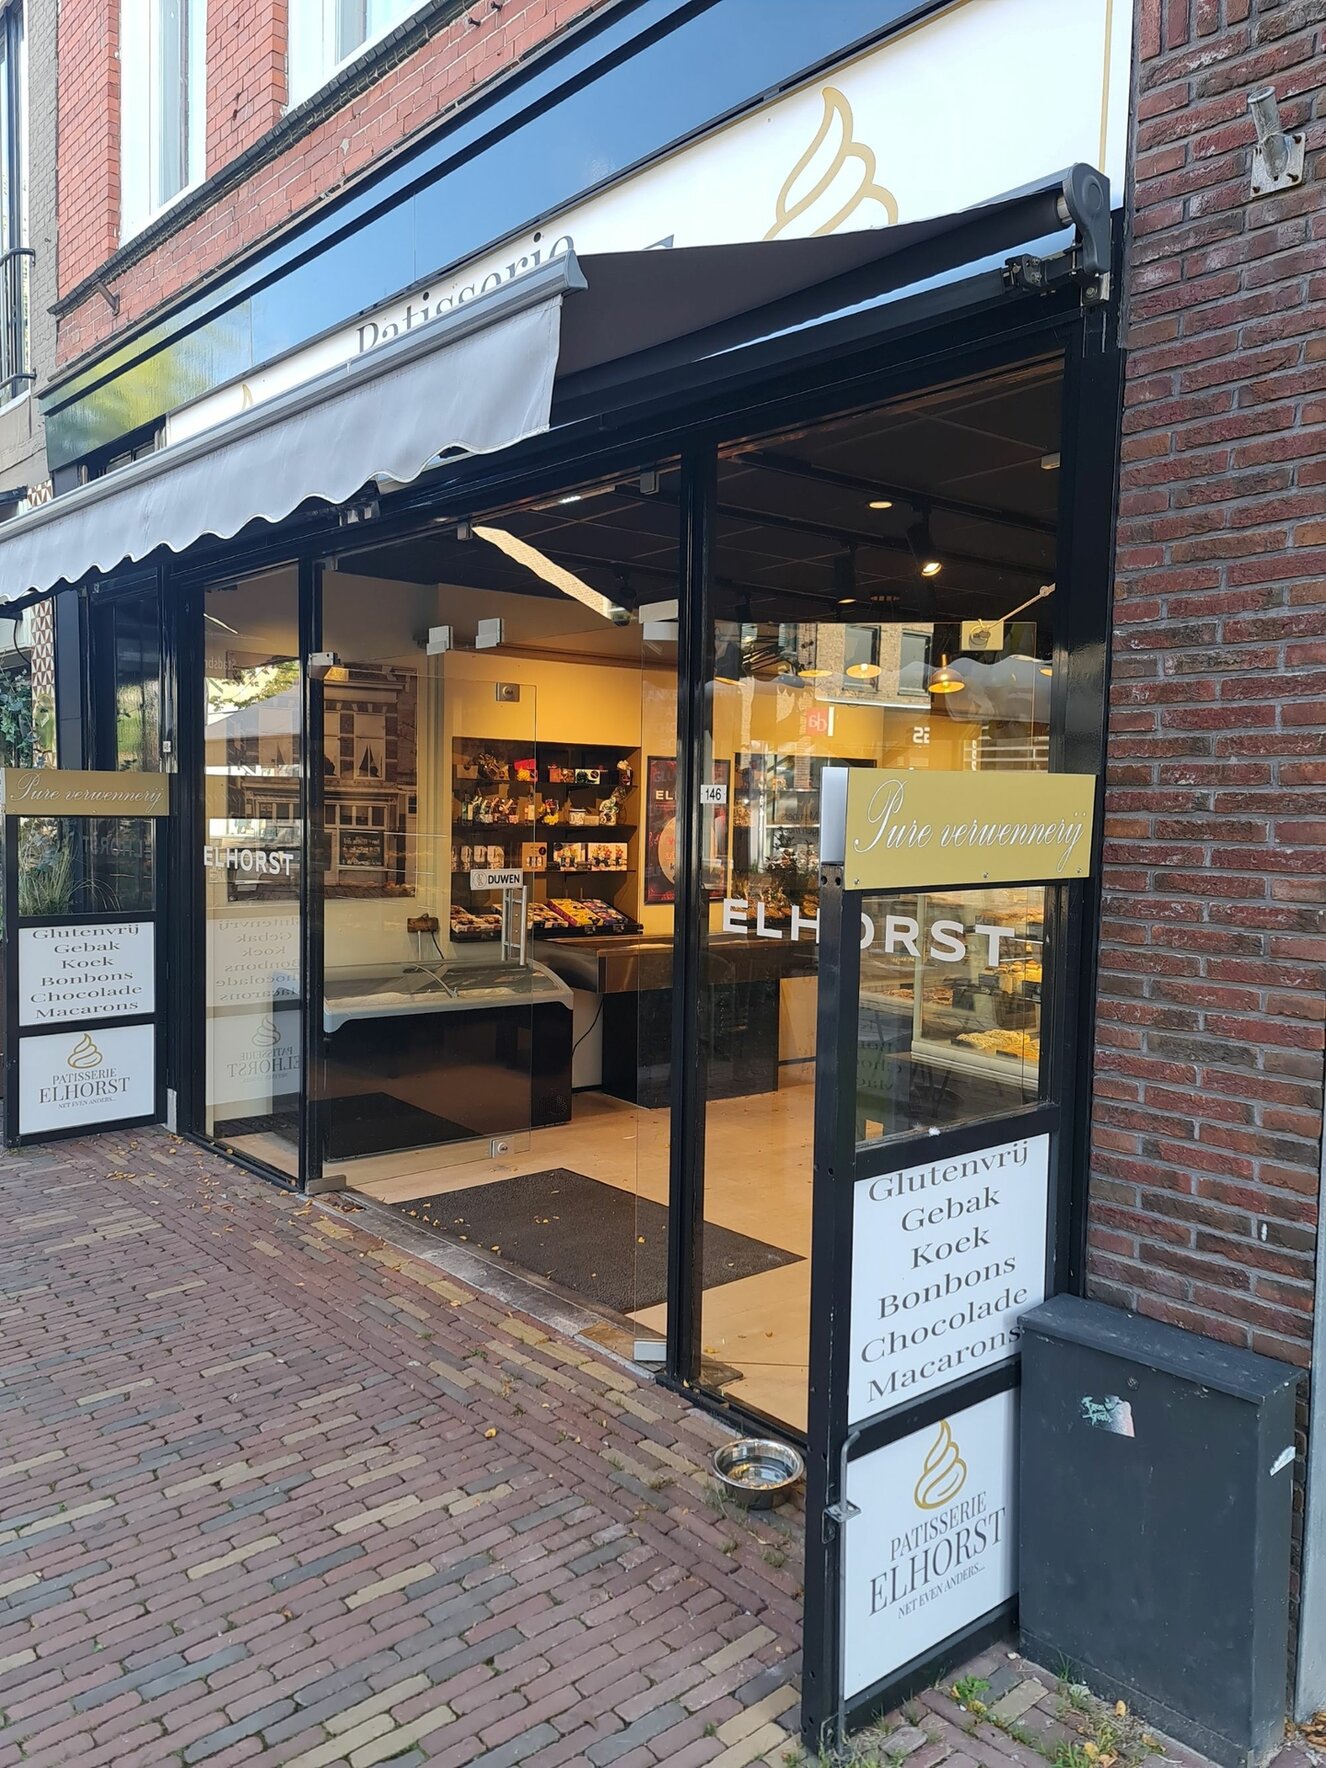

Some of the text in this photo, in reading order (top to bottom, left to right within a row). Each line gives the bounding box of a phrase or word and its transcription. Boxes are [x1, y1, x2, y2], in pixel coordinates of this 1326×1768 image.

[10, 772, 165, 813] Pure verwennerij
[655, 790, 677, 800] EL
[705, 787, 722, 801] 146
[854, 779, 1087, 873] Pure verwennerij
[204, 845, 294, 876] ELHORST
[487, 874, 520, 885] DUWEN
[32, 924, 139, 939] Glutenvrij
[54, 941, 121, 954] Gebak
[61, 957, 115, 969] Koek
[40, 971, 134, 987] Bonbons
[30, 985, 143, 1003] Chocolade
[35, 1001, 139, 1019] Macarons
[39, 1076, 131, 1104] ELHORST
[52, 1067, 117, 1085] PATISSERIE
[58, 1102, 71, 1110] NET
[868, 1140, 1028, 1202] Glutenvrij
[901, 1186, 1001, 1232] Gebak
[911, 1226, 991, 1270] Koek
[877, 1256, 1017, 1320] Bonbons
[861, 1287, 1028, 1363] Chocolade
[866, 1326, 1022, 1404] Macarons
[890, 1491, 987, 1562] PATISSERIE
[868, 1507, 1006, 1617] ELHORST
[898, 1598, 918, 1619] NET
[919, 1579, 944, 1607] EVEN
